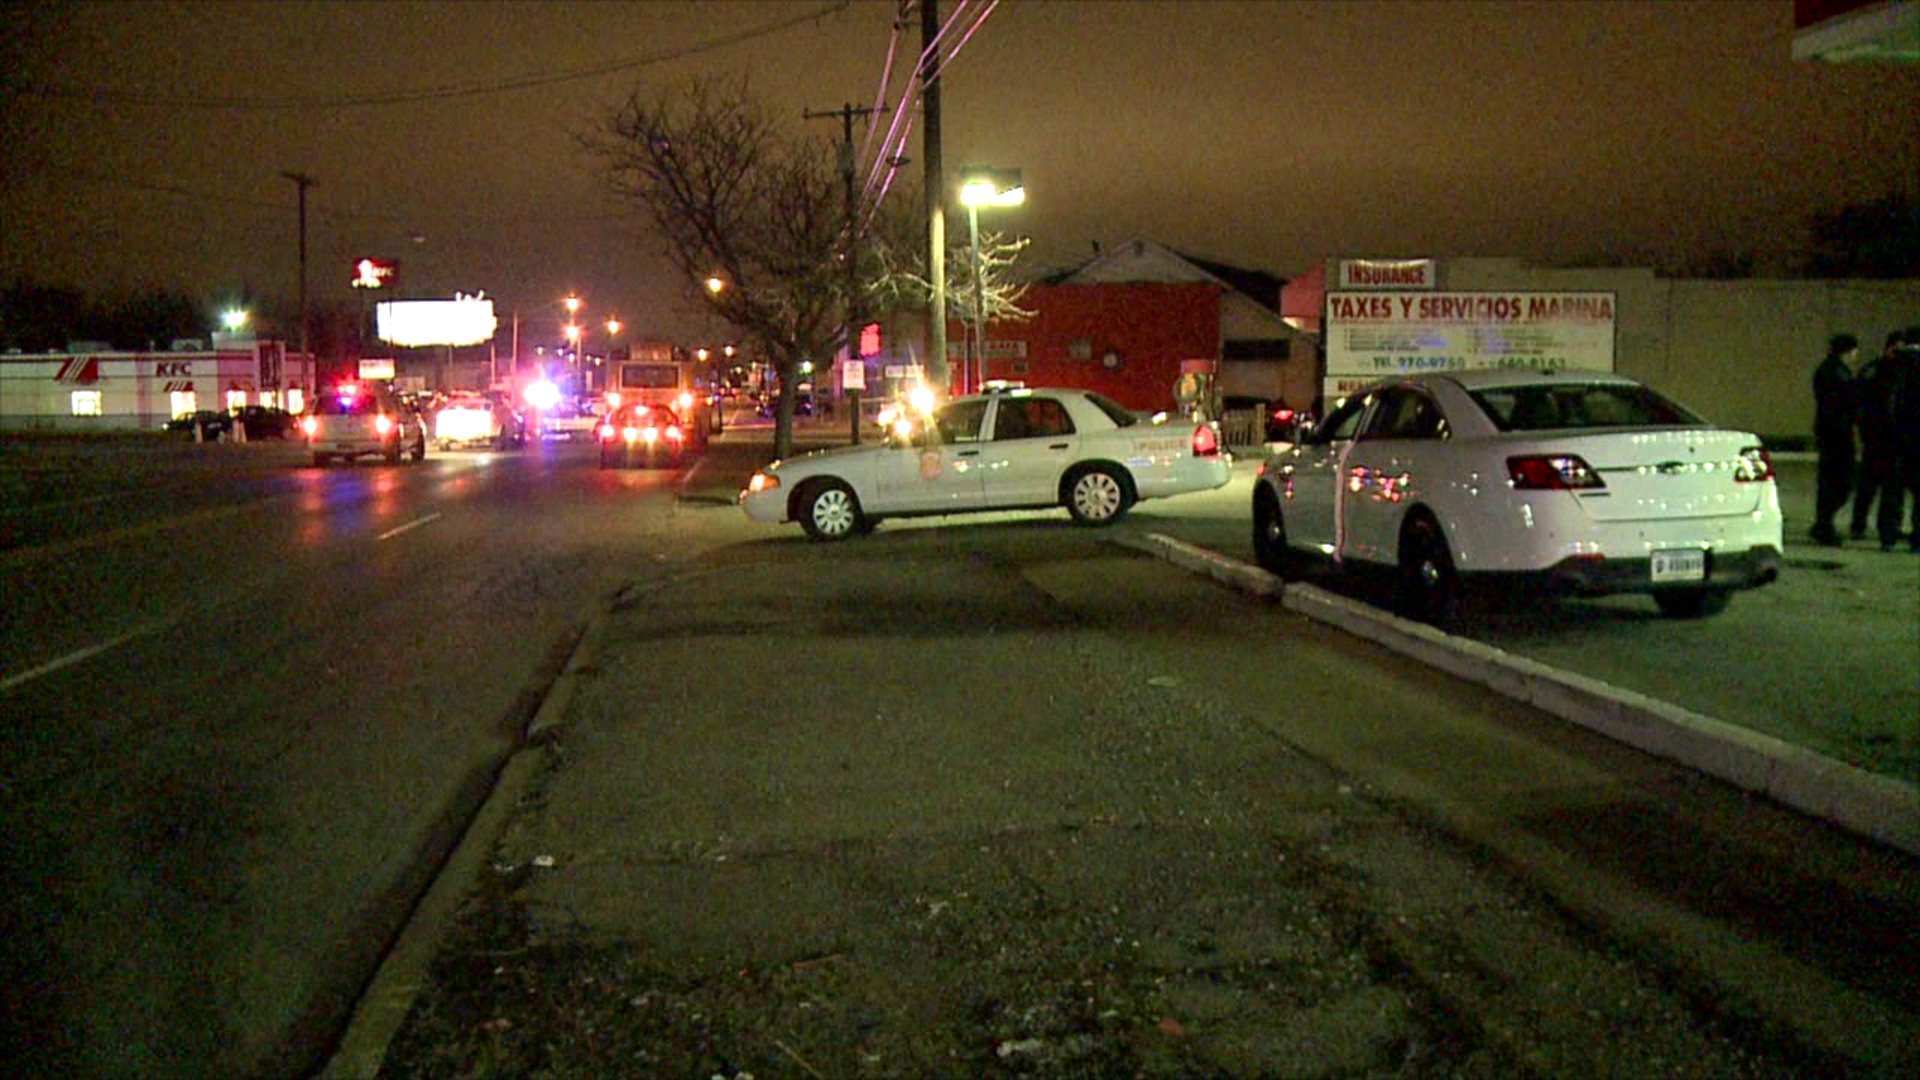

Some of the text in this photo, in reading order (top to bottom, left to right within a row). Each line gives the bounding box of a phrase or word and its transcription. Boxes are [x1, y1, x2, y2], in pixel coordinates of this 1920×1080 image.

[373, 266, 395, 277] KFC
[1348, 262, 1425, 284] INSURANCE
[1331, 297, 1612, 319] TAXES Y SERVICIOS MARINA
[156, 362, 193, 377] KFC
